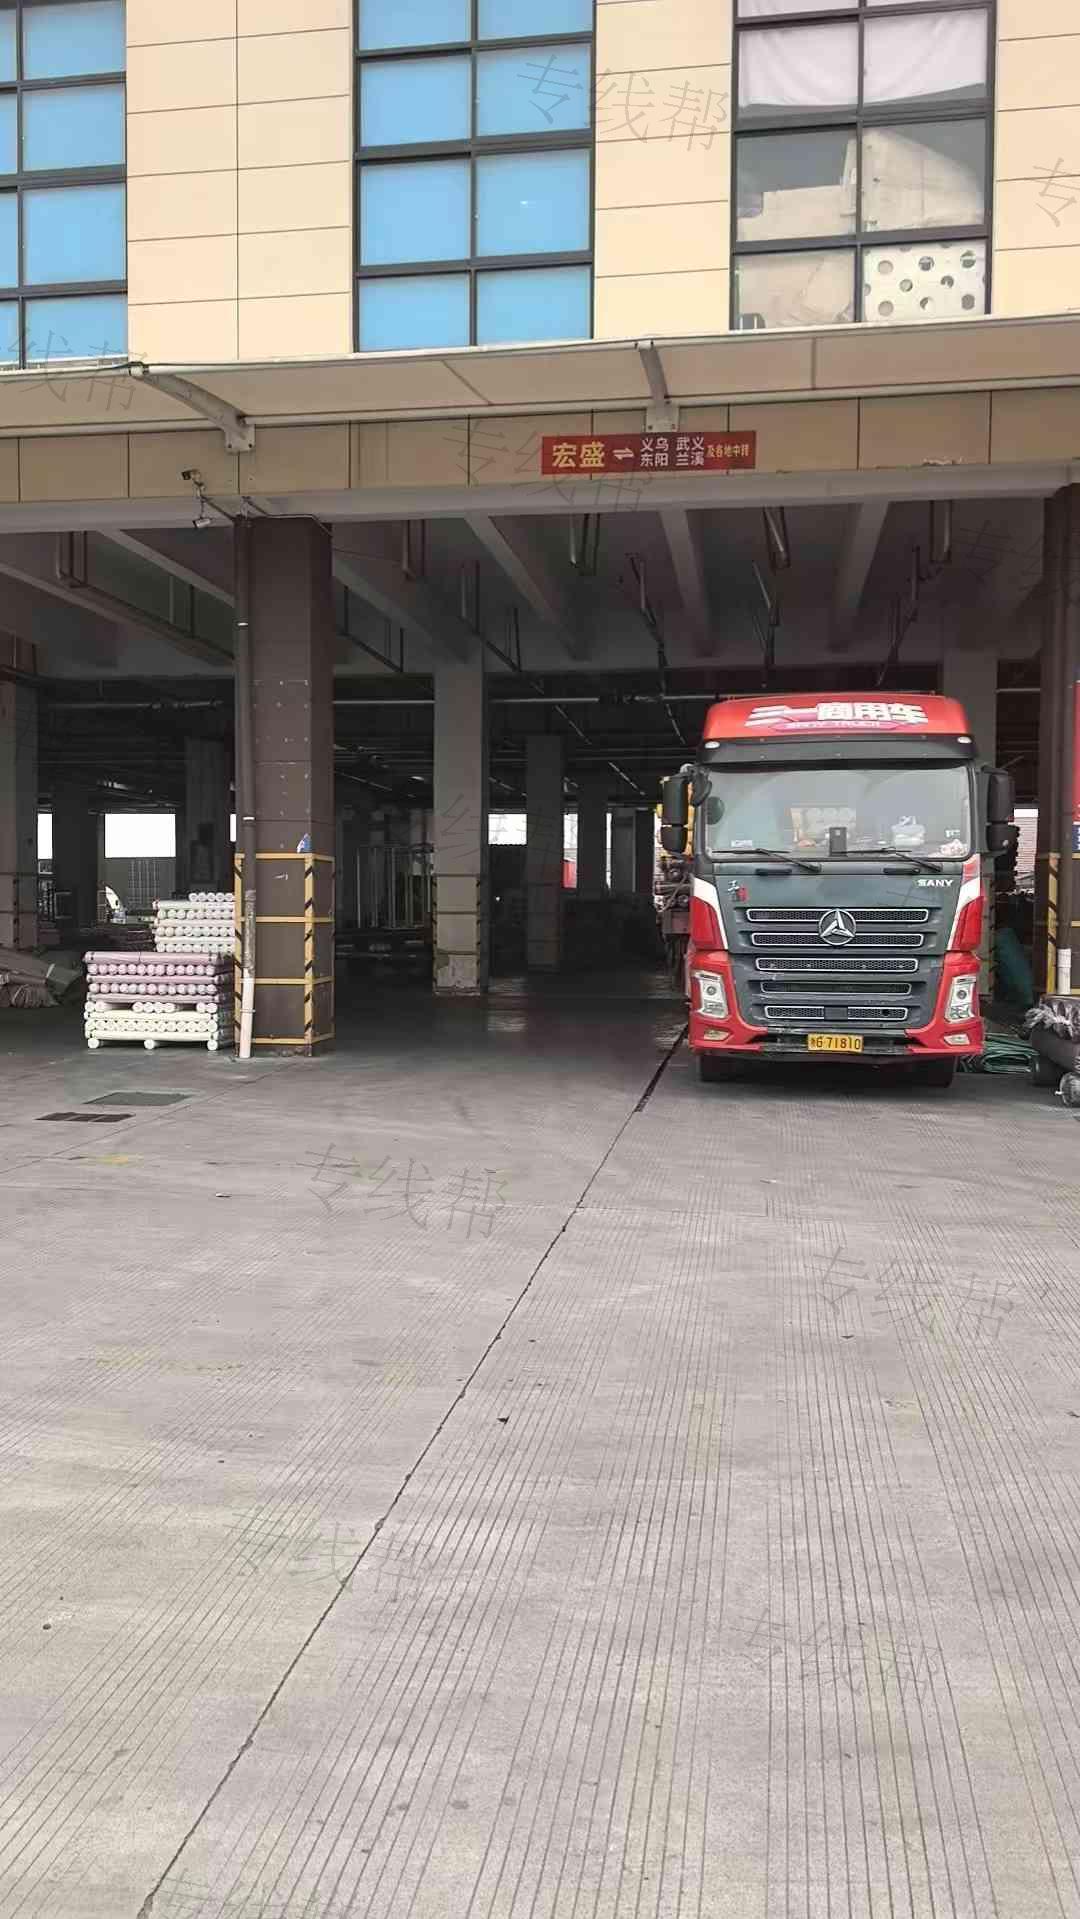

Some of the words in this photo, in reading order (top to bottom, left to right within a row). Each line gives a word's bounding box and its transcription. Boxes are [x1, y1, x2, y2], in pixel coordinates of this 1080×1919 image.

[640, 437, 669, 452] 义乌
[676, 436, 704, 451] 武义
[552, 442, 605, 468] 宏盛
[640, 453, 669, 467] 东阳
[916, 879, 954, 888] SANY
